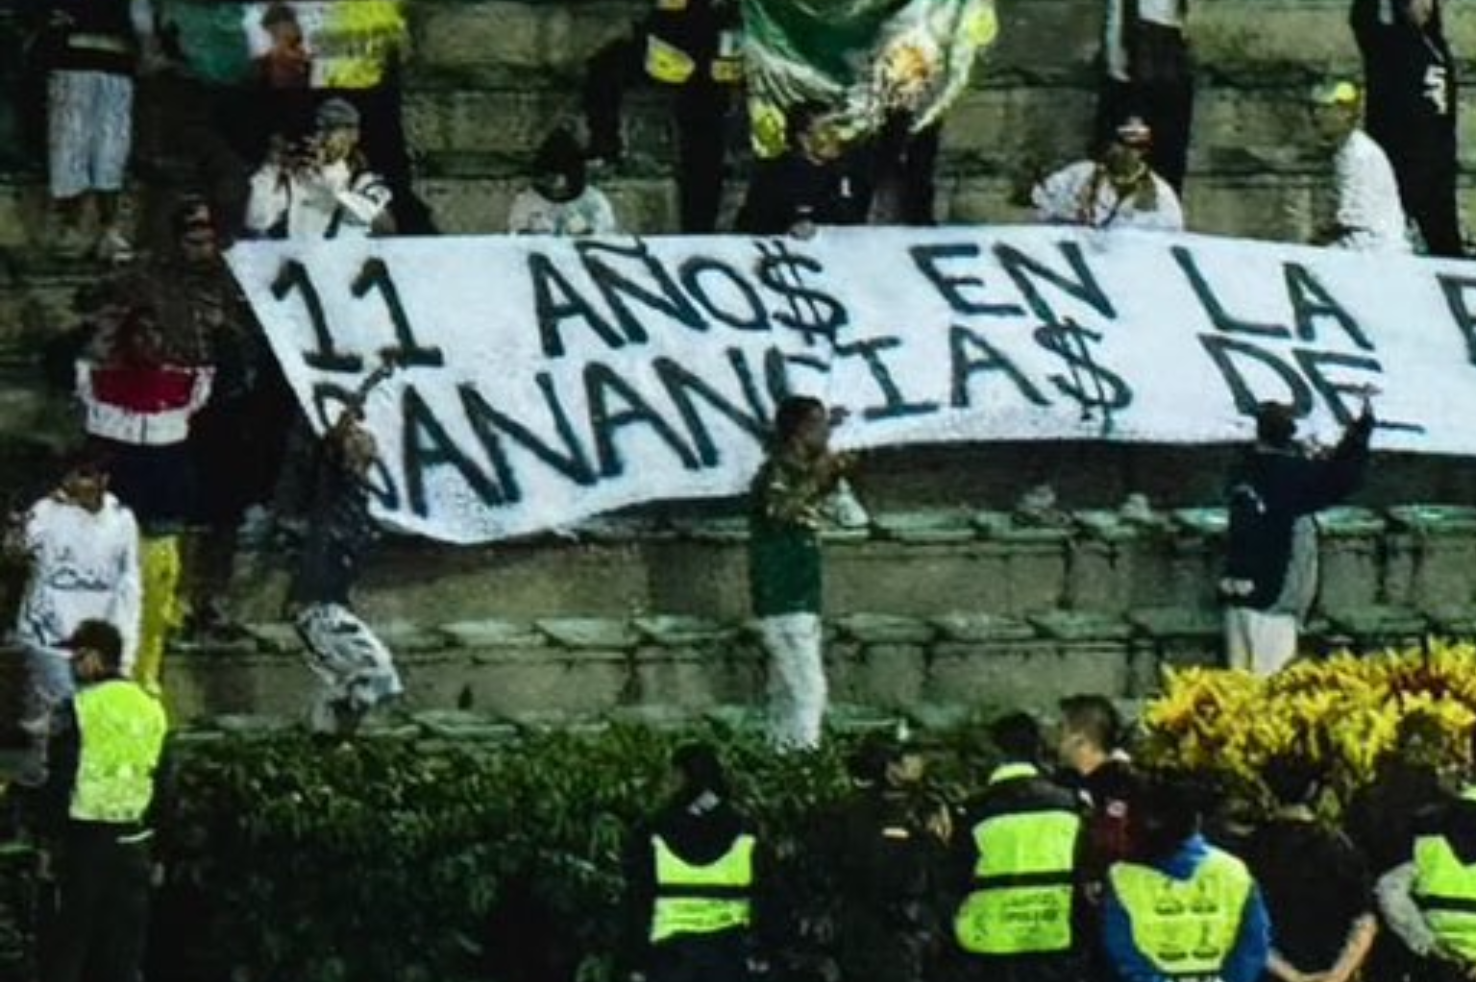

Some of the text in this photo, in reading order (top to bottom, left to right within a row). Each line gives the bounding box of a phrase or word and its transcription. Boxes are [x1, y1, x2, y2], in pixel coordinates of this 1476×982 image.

[270, 256, 443, 374] 11
[909, 241, 1118, 326] EN
[1171, 246, 1376, 350] LA
[1198, 333, 1424, 434] DE
